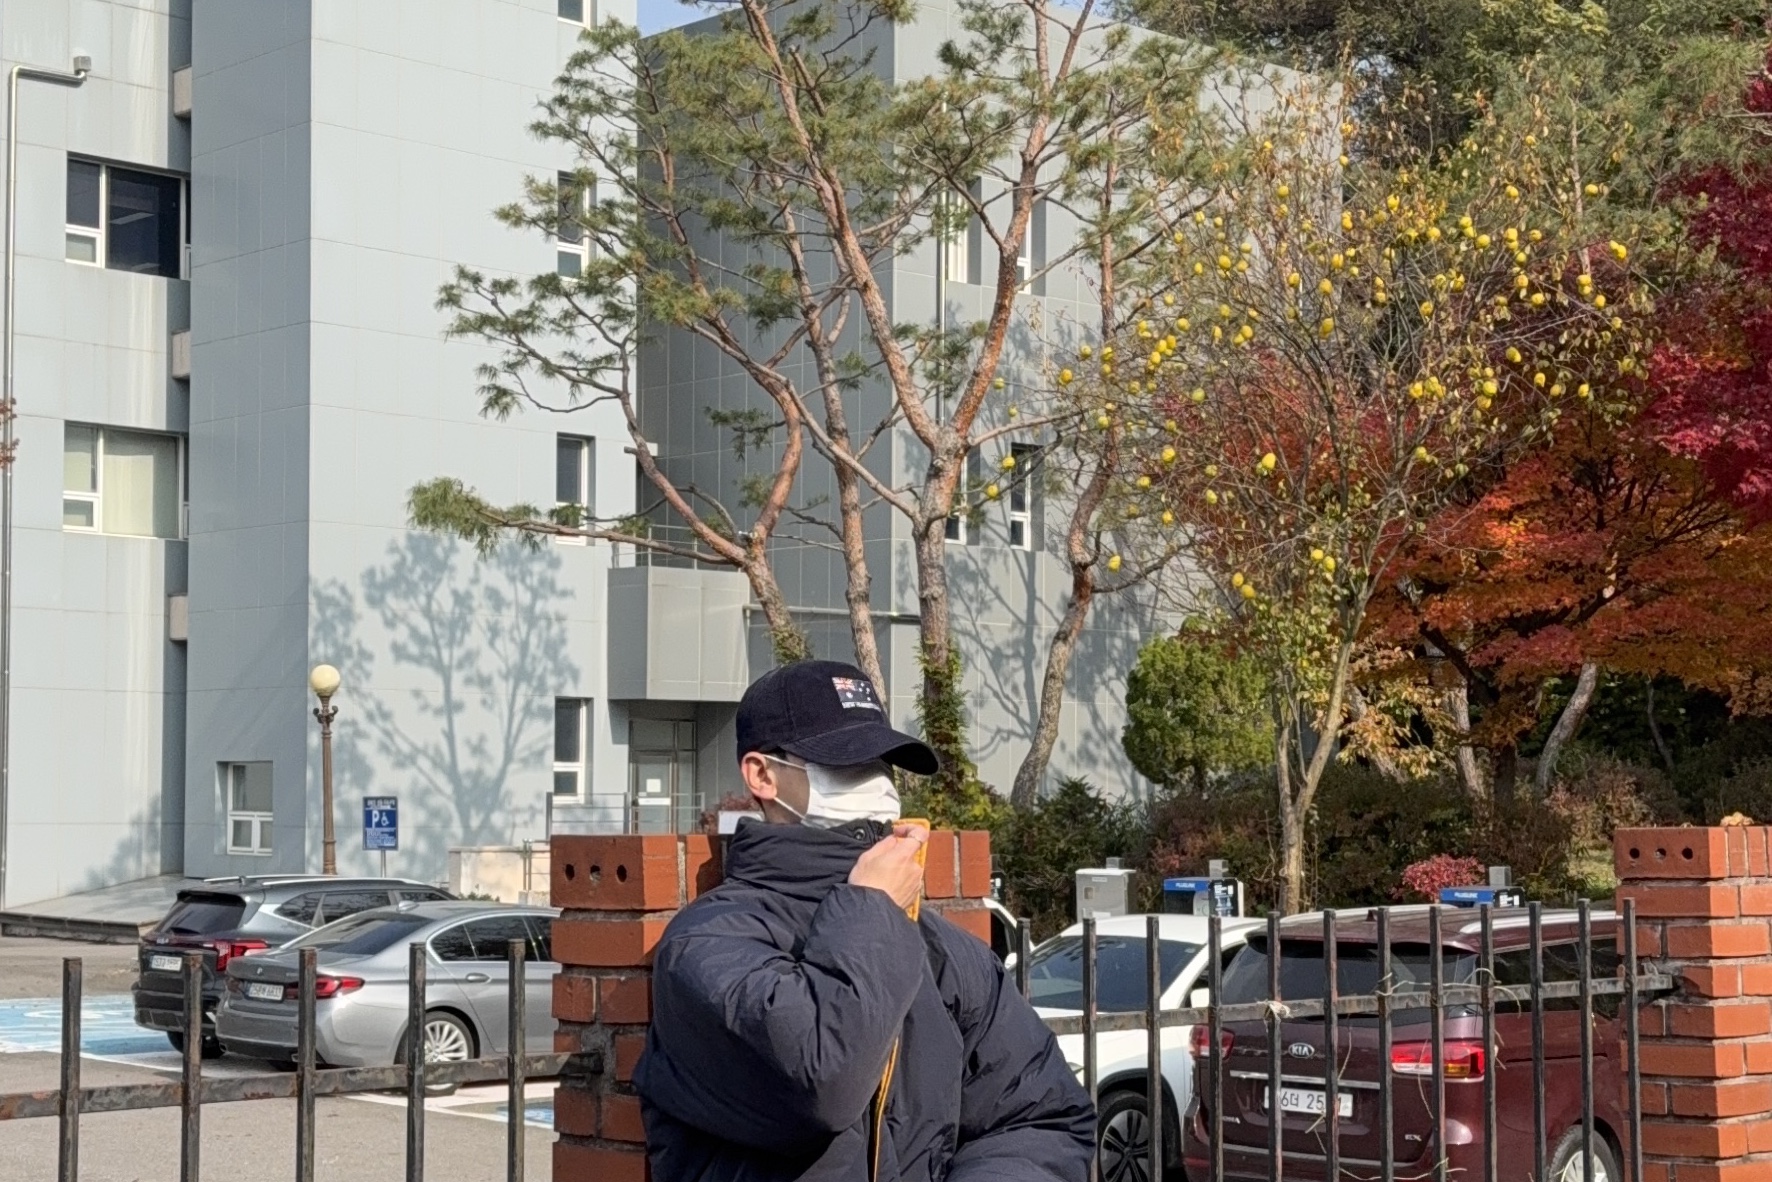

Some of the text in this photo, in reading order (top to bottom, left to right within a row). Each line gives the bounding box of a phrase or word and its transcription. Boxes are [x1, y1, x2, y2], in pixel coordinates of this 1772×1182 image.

[371, 810, 380, 829] P
[1291, 1045, 1310, 1056] KIA
[1273, 1091, 1299, 1108] 6더
